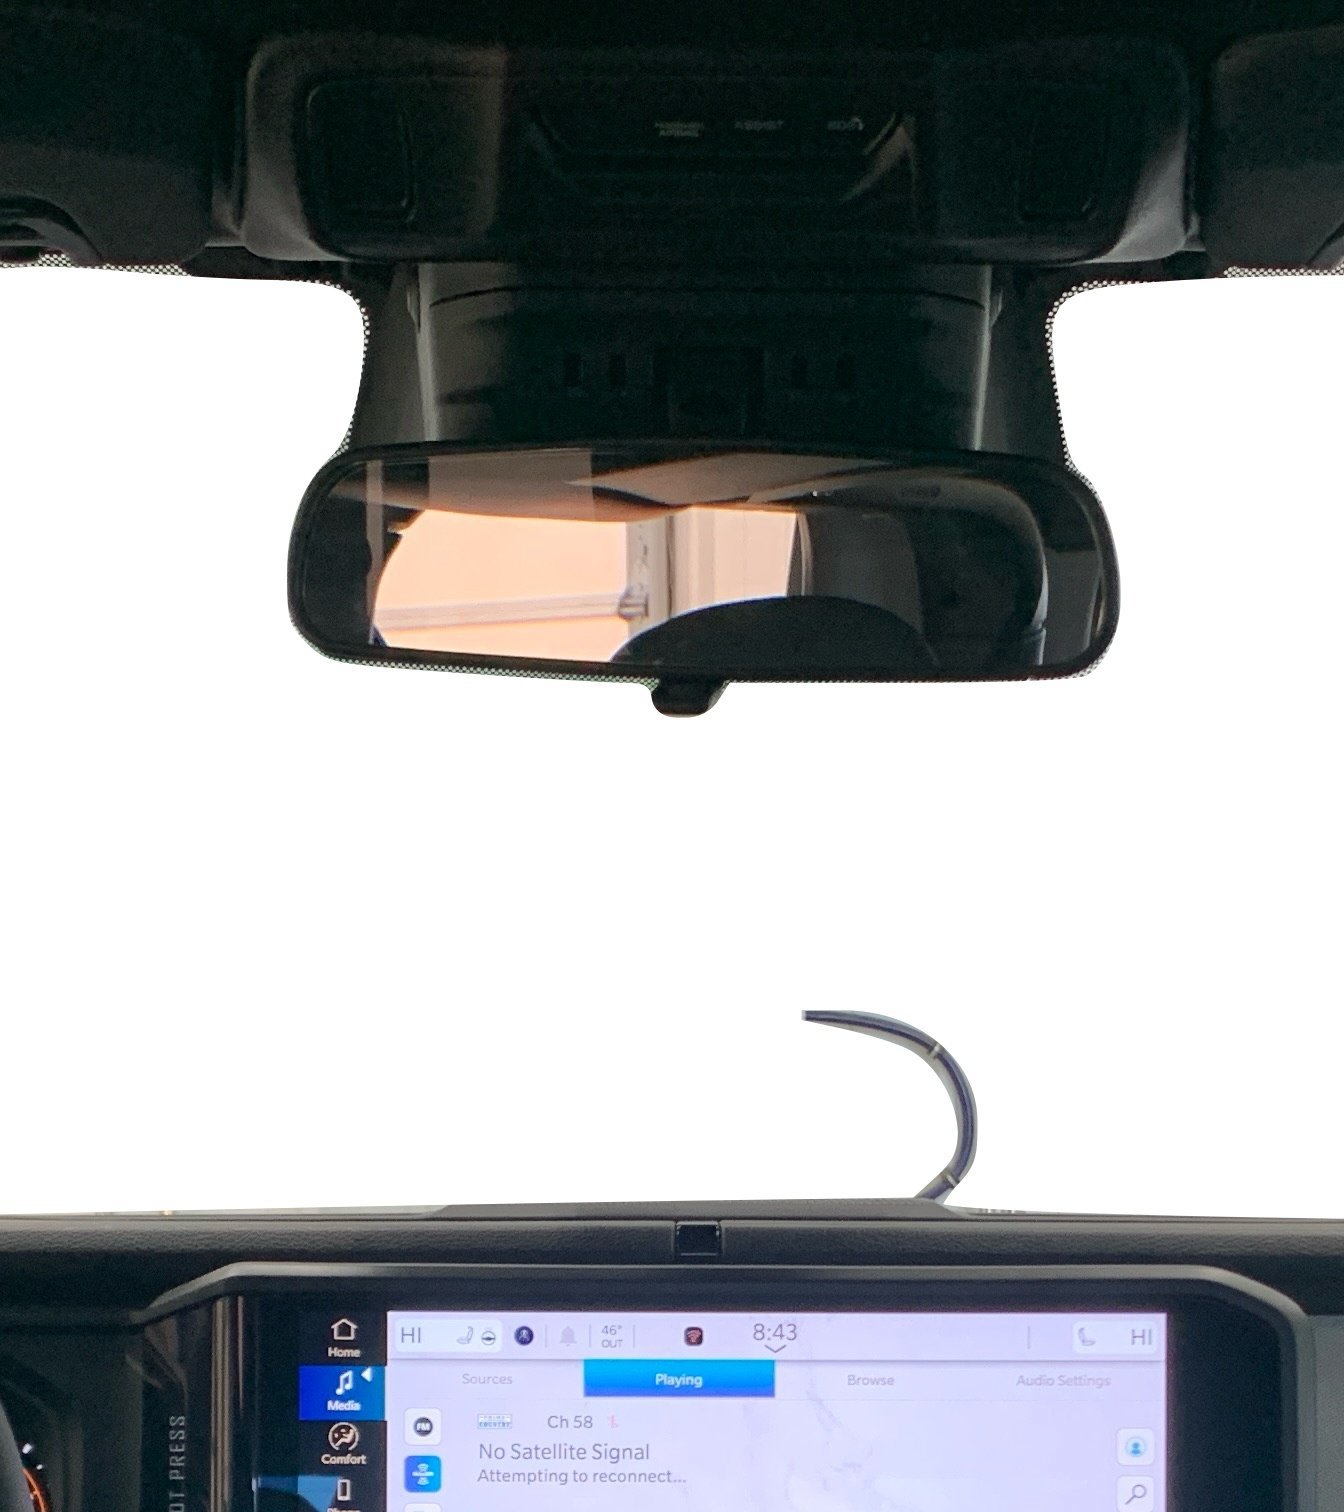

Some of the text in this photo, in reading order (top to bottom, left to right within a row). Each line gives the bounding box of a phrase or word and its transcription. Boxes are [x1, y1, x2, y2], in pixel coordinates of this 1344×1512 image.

[400, 1327, 422, 1343] HI
[601, 1324, 623, 1336] 46°
[753, 1323, 798, 1342] 8:43
[1130, 1328, 1153, 1346] HI
[601, 1339, 624, 1348] OUT
[327, 1347, 361, 1358] Home
[461, 1373, 513, 1385] Sources
[655, 1372, 703, 1388] Playing
[847, 1374, 895, 1386] Browse
[1015, 1373, 1112, 1389] Audio Settings
[327, 1400, 361, 1411] Media
[547, 1415, 593, 1429] Ch 58
[168, 1415, 187, 1481] PRESS
[478, 1443, 651, 1464] No Satellite Signal
[321, 1453, 367, 1465] Comfort
[476, 1468, 687, 1486] Attempting to reconnect...
